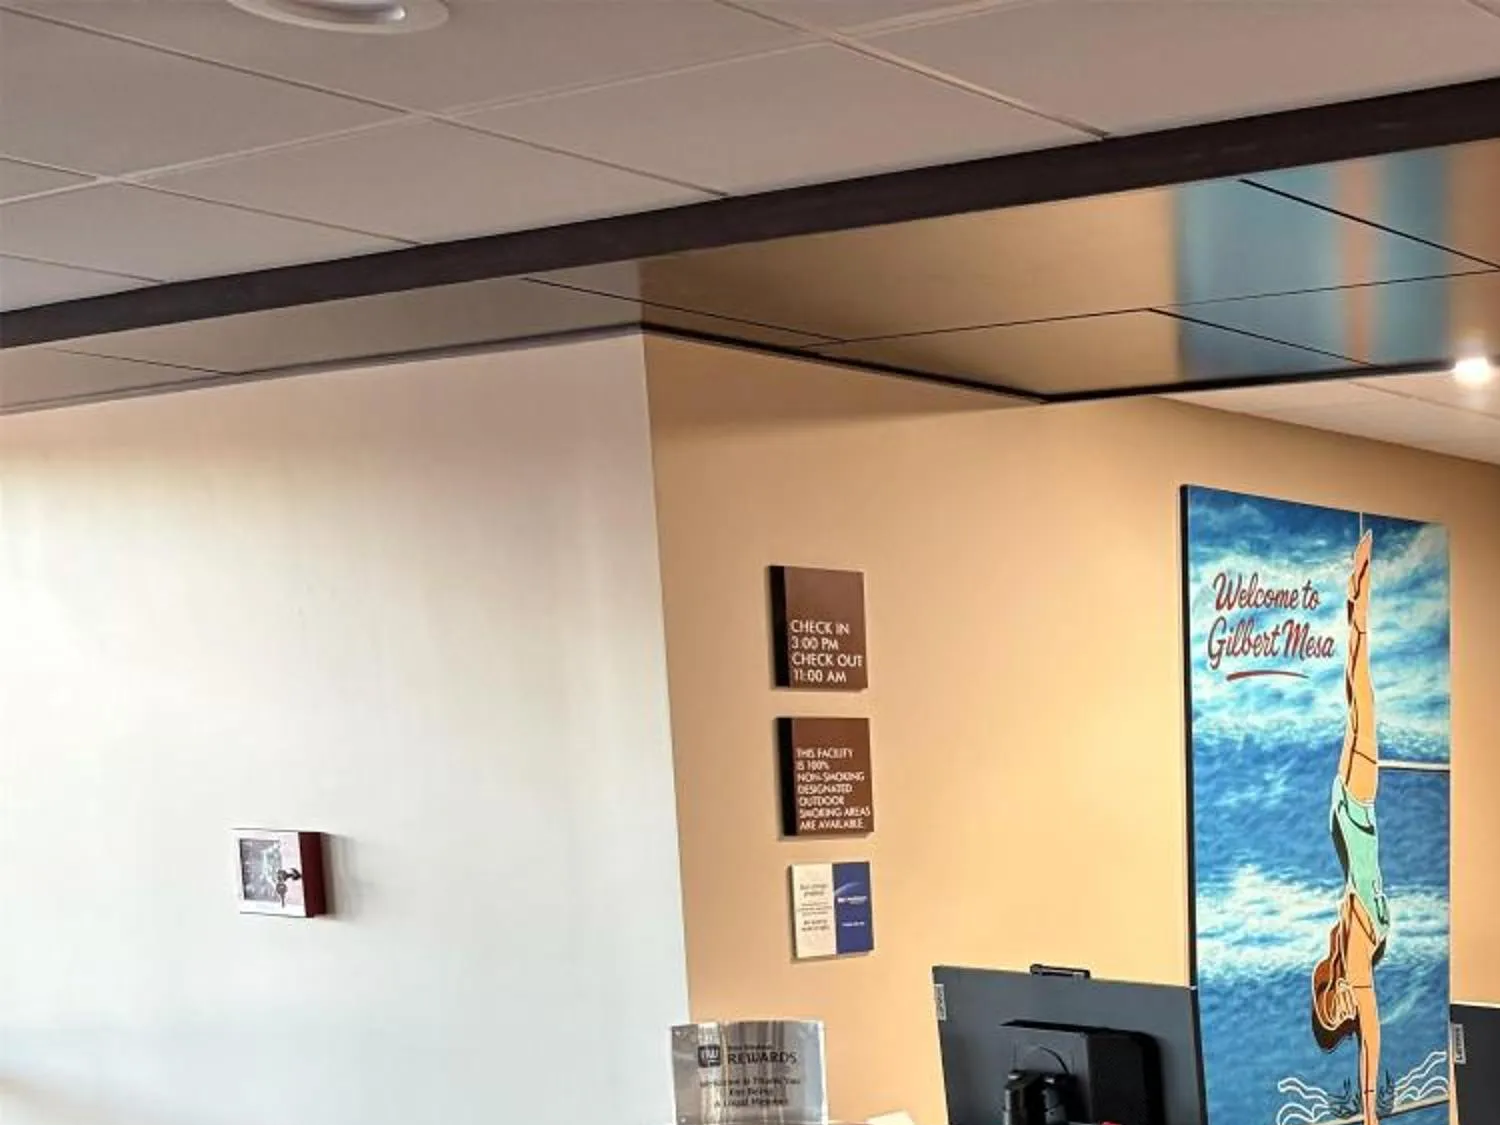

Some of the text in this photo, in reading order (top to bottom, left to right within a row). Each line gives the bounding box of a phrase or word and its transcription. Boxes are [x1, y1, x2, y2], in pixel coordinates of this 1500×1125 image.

[1212, 572, 1321, 611] Welcome to
[790, 619, 850, 635] CHECK IN
[821, 638, 839, 650] PM
[1207, 616, 1336, 669] Gilbert Mesa
[791, 652, 863, 667] CHECK OUT
[826, 671, 847, 683] AM
[817, 748, 853, 758] FACILITY
[806, 760, 830, 771] 100%
[797, 772, 865, 782] NON-SMOKING
[797, 784, 853, 794] DESIGNATED
[798, 796, 844, 806] OUTDOOR
[799, 806, 871, 819] SMOKING AREAS
[799, 818, 863, 831] ARE AVAILABLE
[727, 1051, 797, 1065] REWARDS
